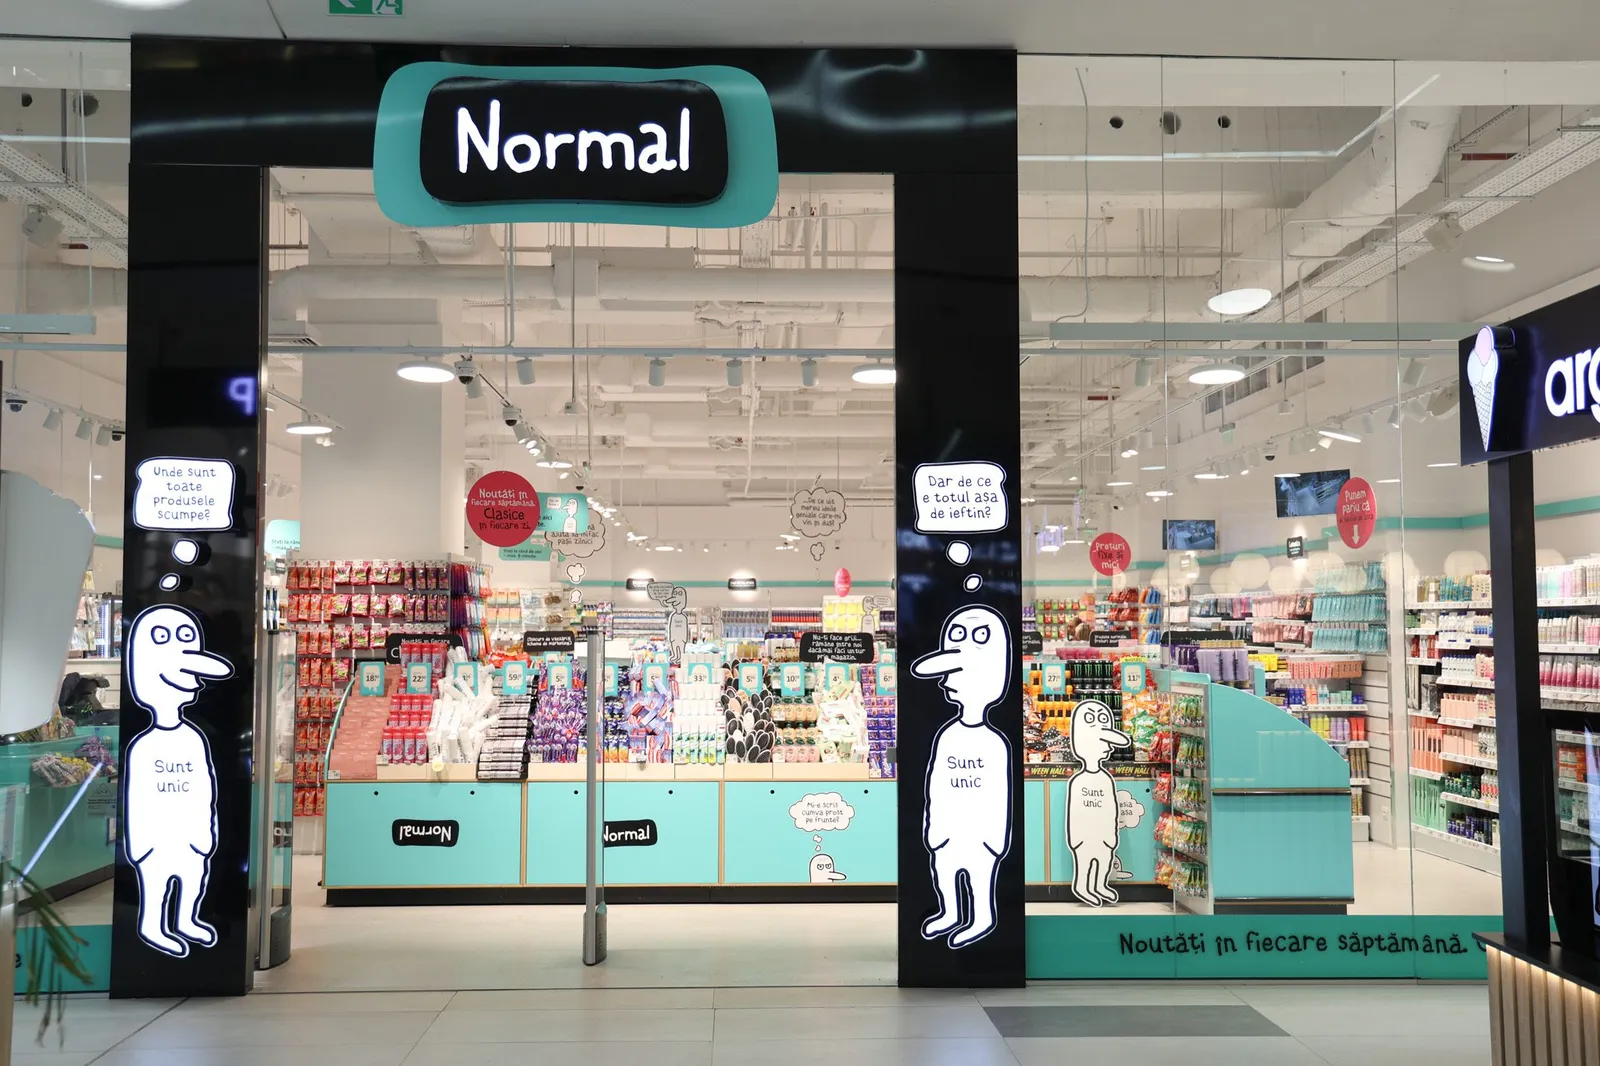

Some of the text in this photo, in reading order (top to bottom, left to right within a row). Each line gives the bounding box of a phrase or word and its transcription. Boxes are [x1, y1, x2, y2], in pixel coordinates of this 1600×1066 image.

[457, 99, 690, 174] Normal
[153, 466, 216, 478] Unde sunt
[166, 482, 202, 492] toate
[928, 475, 992, 488] Dar de ce
[153, 494, 215, 507] produsele
[471, 498, 496, 507] fiecare
[922, 494, 930, 503] e
[934, 491, 970, 503] totul
[157, 509, 211, 522] scumpe?
[483, 508, 525, 521] Clasice
[930, 506, 991, 518] de ieftin?
[490, 520, 519, 529] fiecare
[1101, 559, 1120, 569] mici
[154, 759, 194, 773] Sunt
[947, 755, 985, 769] Sunt
[157, 779, 190, 793] unic
[950, 775, 982, 788] unic
[1081, 787, 1105, 797] Sunt
[822, 801, 839, 809] scris
[1082, 798, 1103, 808] unic
[825, 809, 844, 817] prost
[805, 816, 840, 824] pe frunte?
[399, 825, 452, 843] Normal
[1119, 932, 1206, 955] Noutăți
[1246, 931, 1328, 953] fiecare
[1338, 931, 1469, 957] săptămână.
